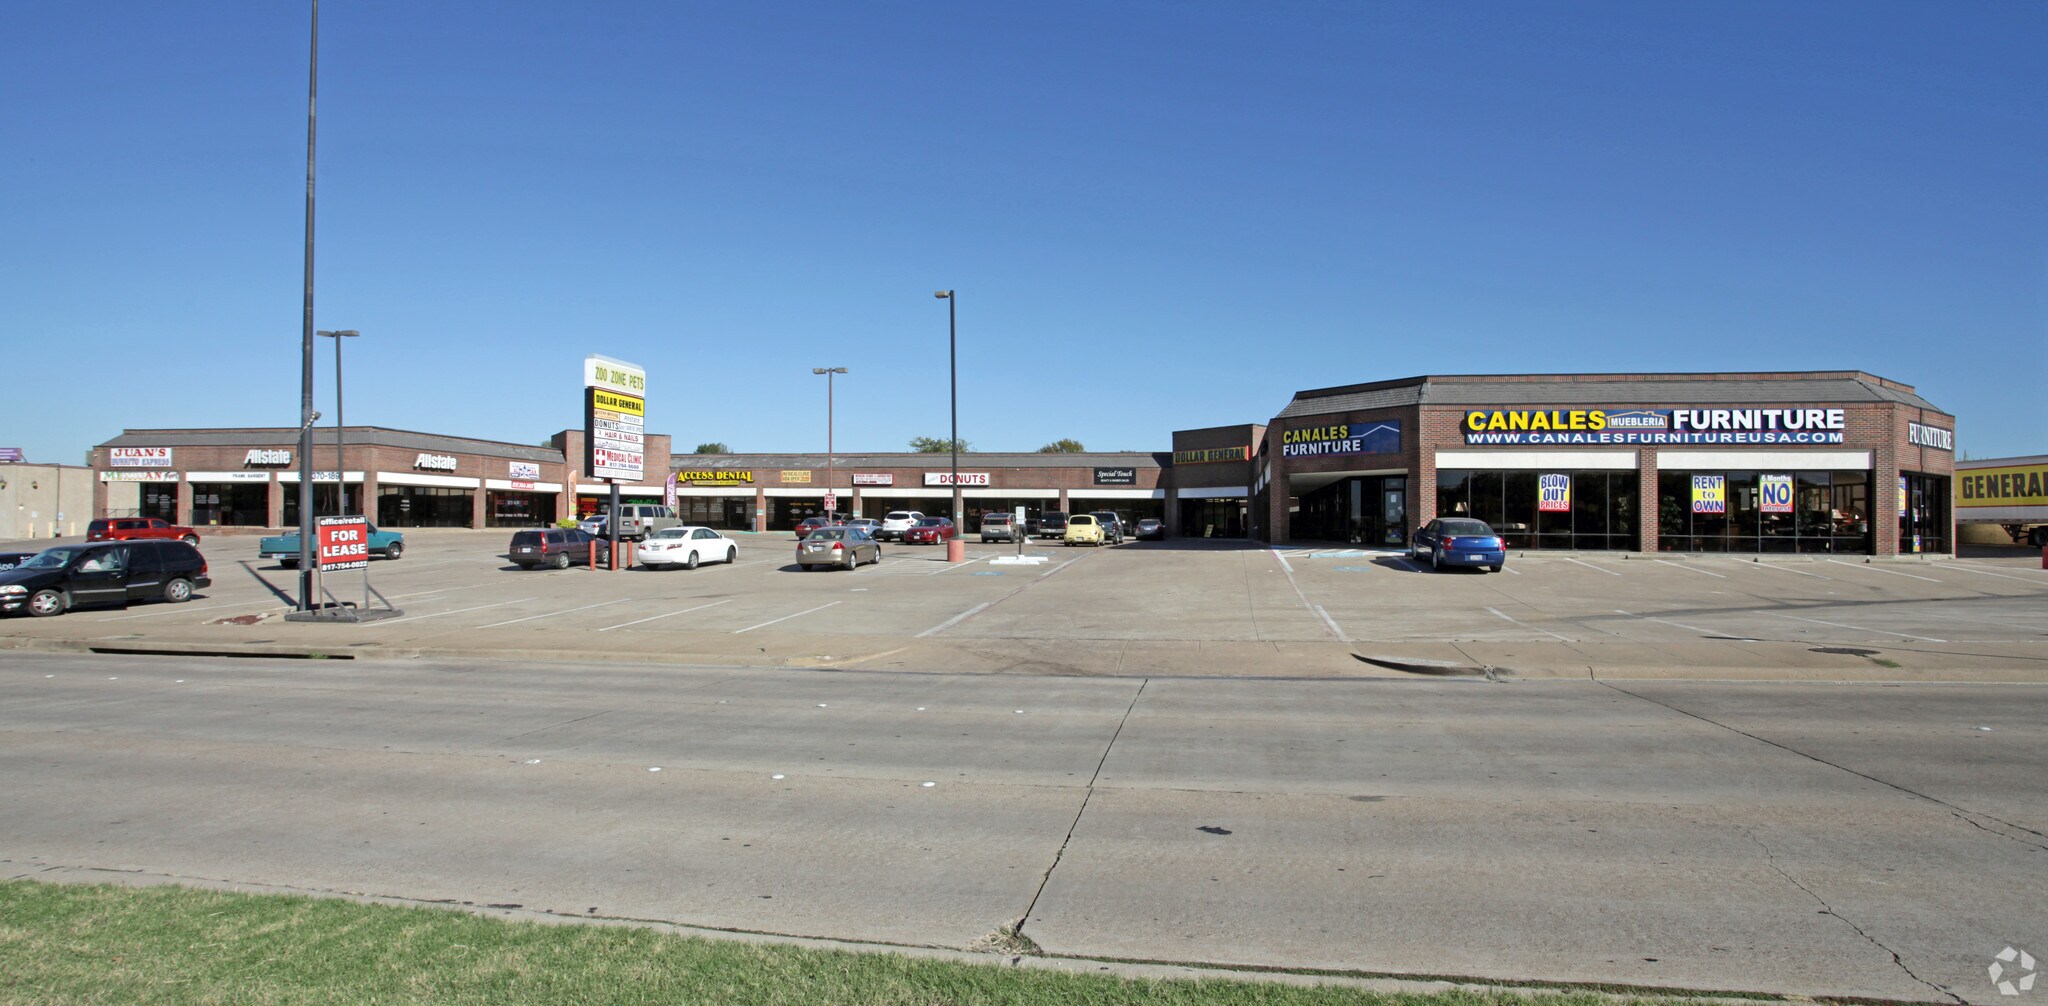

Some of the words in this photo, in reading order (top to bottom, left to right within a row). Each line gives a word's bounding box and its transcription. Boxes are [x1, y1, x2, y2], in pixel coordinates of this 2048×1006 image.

[595, 366, 608, 382] ZOO
[610, 370, 626, 386] ZONE
[629, 374, 644, 390] PETS
[596, 394, 617, 407] DOLLAR
[618, 398, 642, 412] GENERAL
[594, 419, 620, 430] DONUTS
[1467, 411, 1606, 431] CANALES
[1673, 409, 1845, 430] FURNITURE
[1610, 416, 1665, 427] MUEBLERIA
[604, 431, 617, 439] HAIR
[623, 434, 639, 442] NAILS
[1283, 425, 1348, 444] CANALES
[1467, 432, 1843, 444] WWW.CANALESFURNITUREUSA.COM
[1908, 422, 1952, 450] FURNITURE
[114, 448, 167, 457] JUAN'S
[1283, 440, 1361, 456] FURNITURE
[243, 449, 292, 465] Allstate
[1175, 450, 1205, 462] DOLLAR
[1207, 447, 1246, 461] GENERAL
[141, 458, 170, 466] EXPRESS
[414, 453, 457, 470] Allstate
[677, 471, 714, 482] ACCESS
[716, 470, 754, 482] DENTAL
[940, 474, 986, 484] DONUTS
[1097, 470, 1117, 479] Special
[1767, 474, 1791, 482] Months
[1541, 474, 1568, 489] BLOW
[1694, 476, 1723, 489] RENT
[1543, 488, 1566, 501] OUT
[1702, 490, 1716, 499] to
[1762, 483, 1791, 505] NO
[1540, 500, 1568, 509] PRICES
[1694, 500, 1724, 512] OWN
[320, 517, 365, 526] office/retail
[331, 530, 359, 542] FOR
[323, 544, 367, 557] LEASE
[322, 561, 368, 571] 817-754-0022
